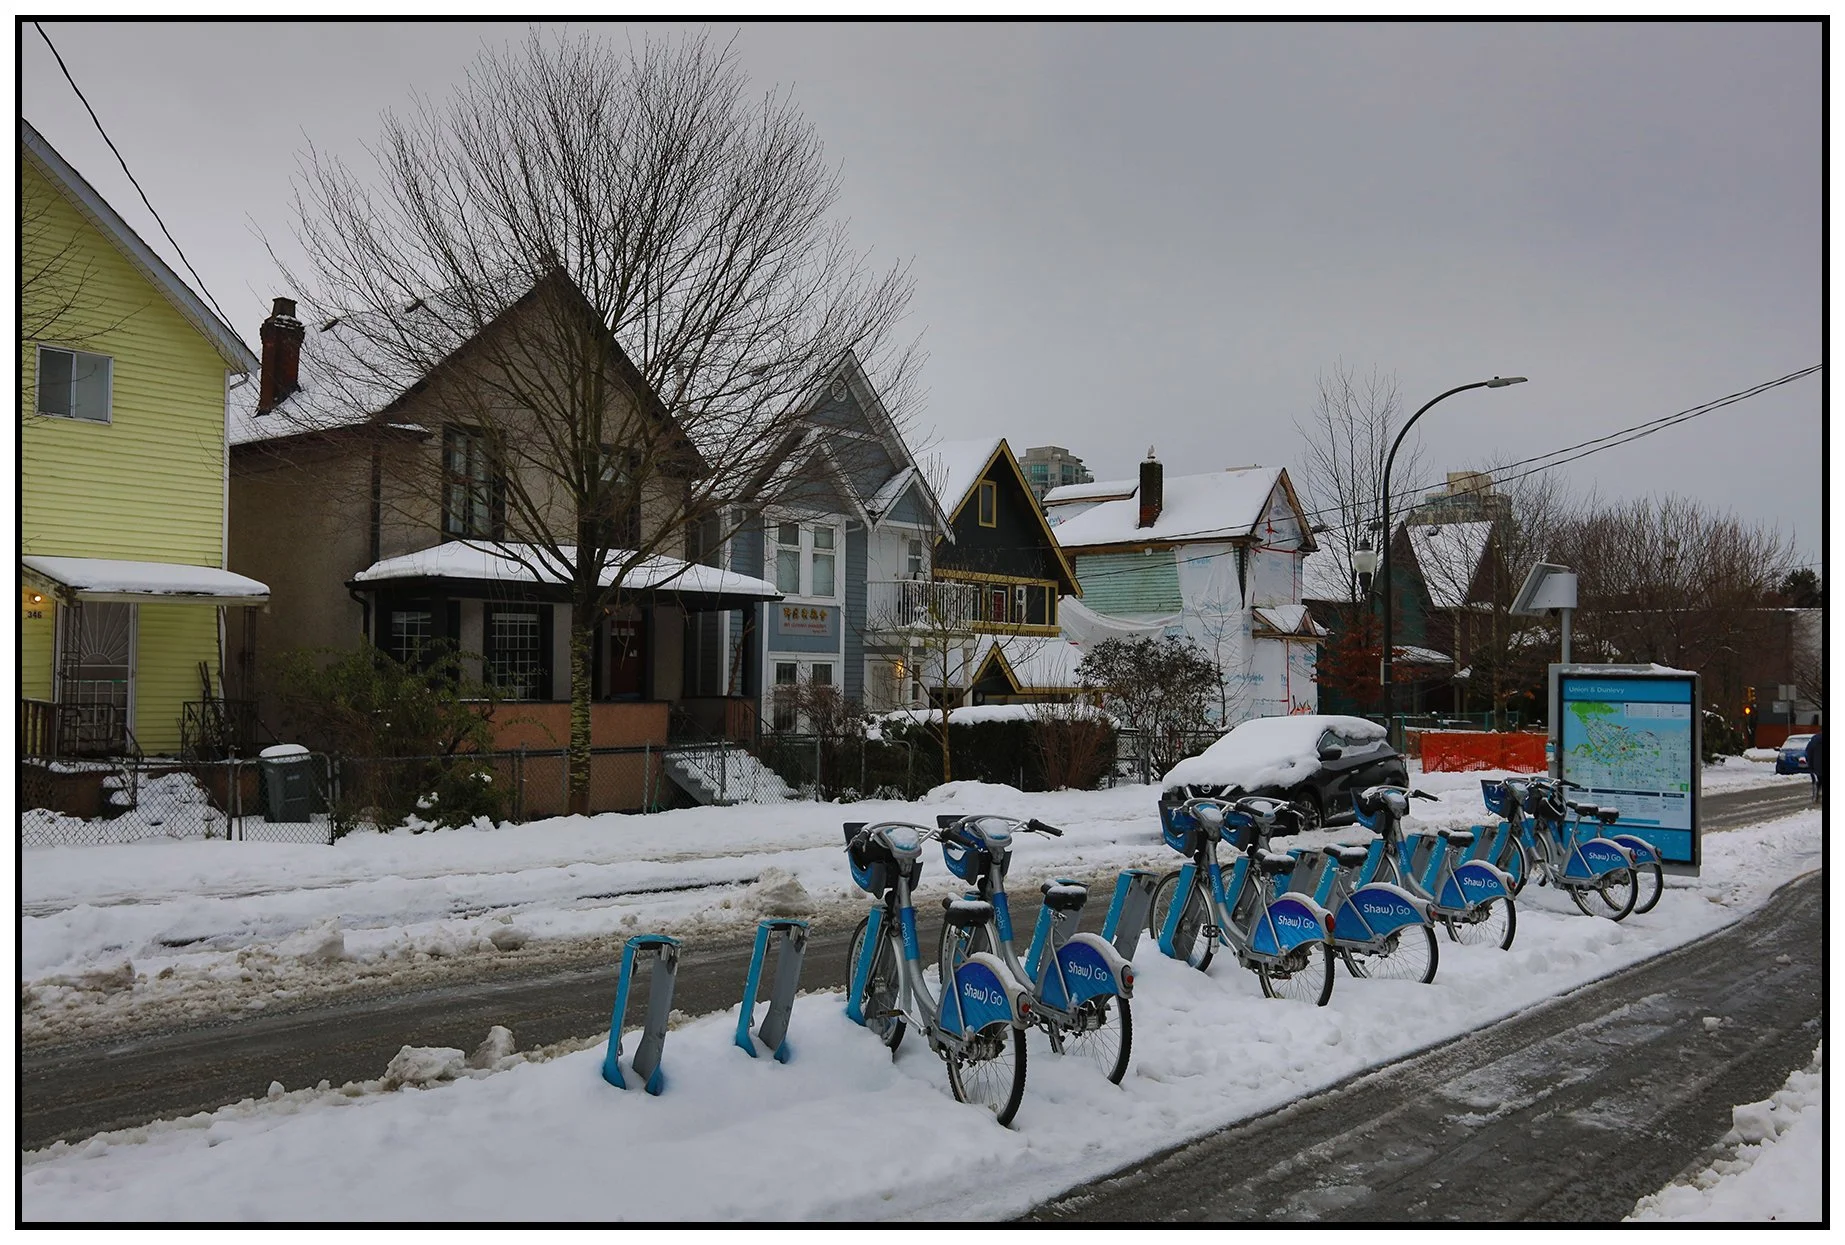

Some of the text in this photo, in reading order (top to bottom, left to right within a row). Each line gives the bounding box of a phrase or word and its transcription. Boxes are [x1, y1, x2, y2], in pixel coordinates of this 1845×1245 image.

[1611, 853, 1622, 862] Go
[1636, 849, 1647, 857] Go
[1487, 879, 1497, 889] Go
[1396, 905, 1411, 916] Go
[1302, 917, 1315, 929] Go
[901, 922, 911, 947] mobi
[1094, 967, 1108, 982] Go
[990, 990, 1003, 1006] Go
